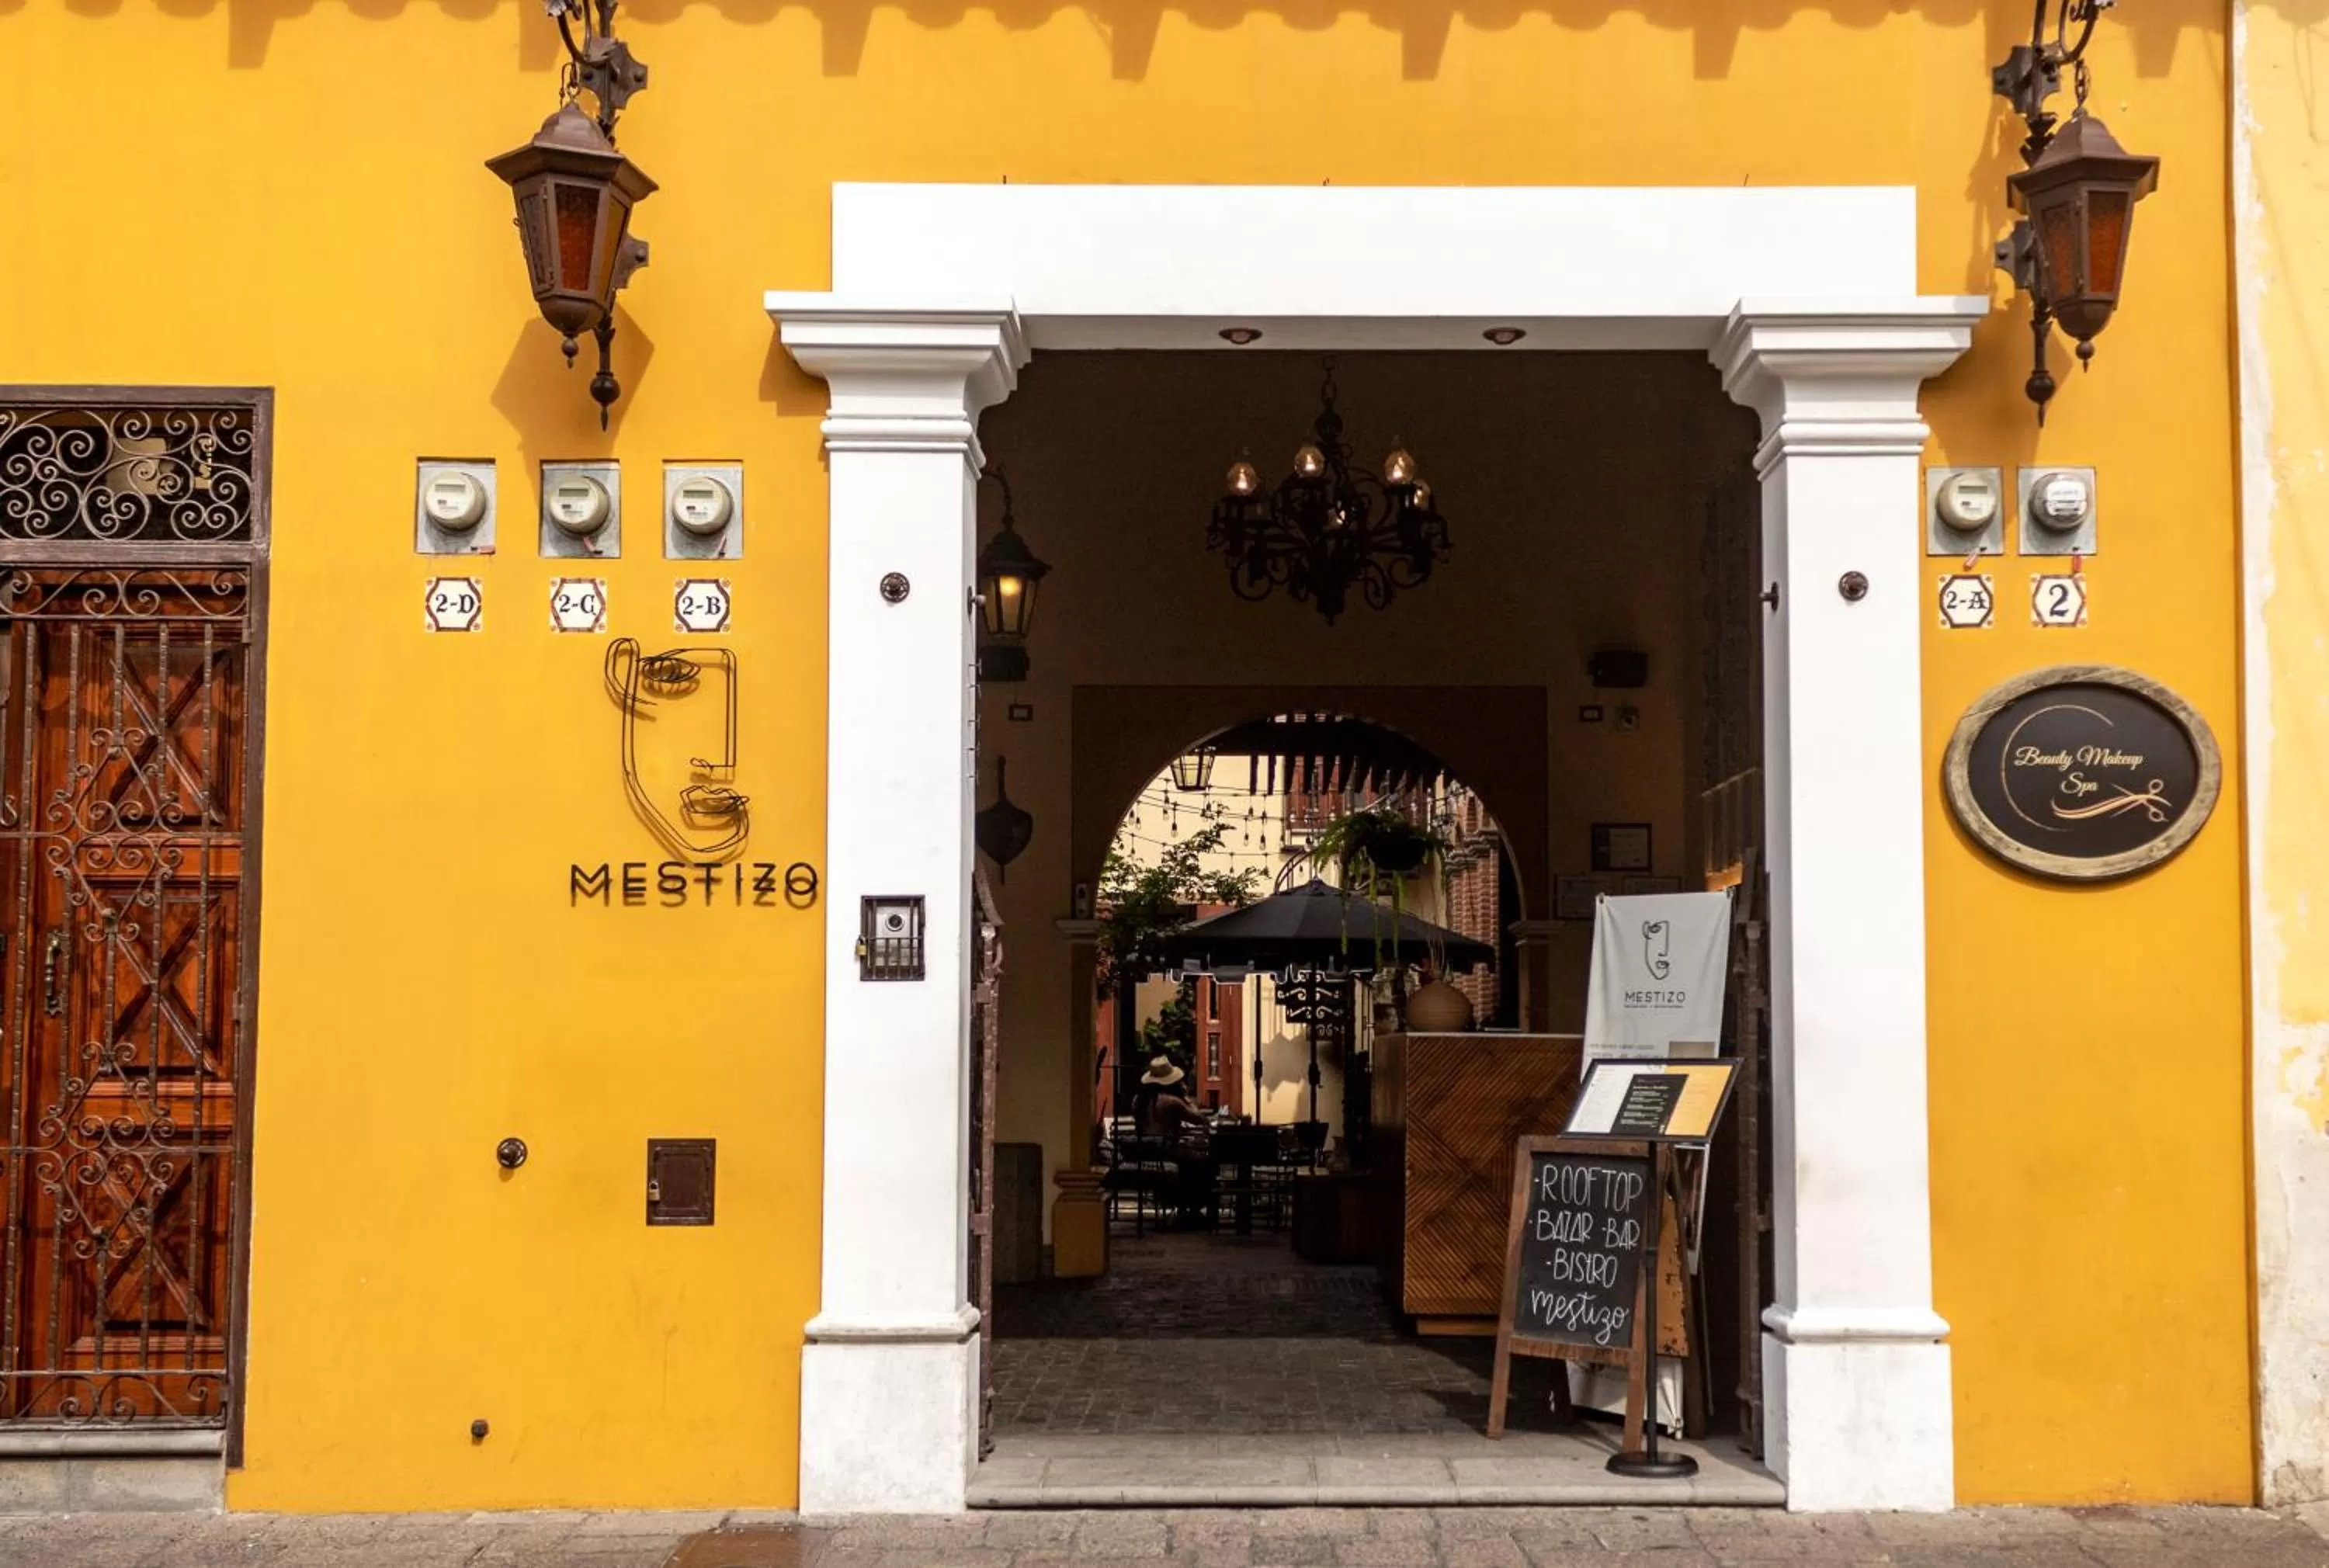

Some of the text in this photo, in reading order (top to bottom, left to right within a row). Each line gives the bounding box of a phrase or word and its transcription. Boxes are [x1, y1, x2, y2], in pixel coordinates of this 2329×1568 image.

[436, 594, 475, 614] 2-D
[682, 596, 721, 616] 2-B
[1945, 591, 1987, 609] 2-A
[2049, 584, 2069, 617] 2
[2014, 744, 2143, 772] Beauty Makeup
[2061, 772, 2098, 797] Spa
[571, 862, 818, 895] MESTIZO
[1625, 991, 1685, 1003] MESTIZO
[1532, 1289, 1630, 1345] mestizo
